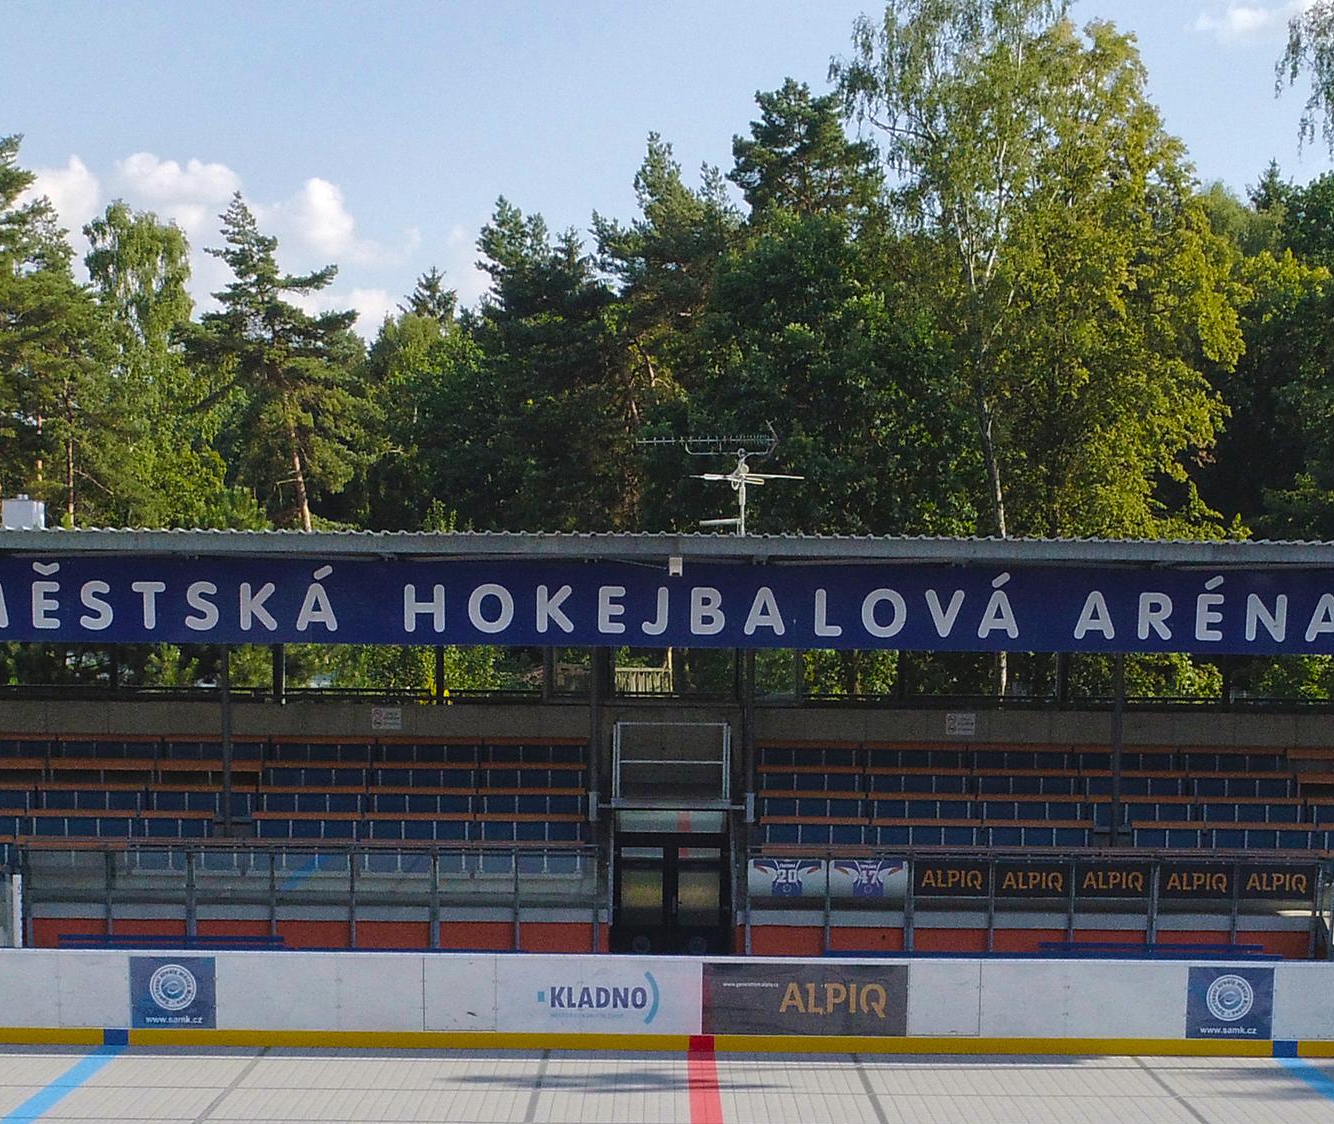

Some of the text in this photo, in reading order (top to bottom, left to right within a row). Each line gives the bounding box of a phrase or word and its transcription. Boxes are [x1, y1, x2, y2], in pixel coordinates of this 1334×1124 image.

[403, 572, 1019, 638] HOKEJBALOVÁ
[777, 869, 797, 883] 20
[921, 870, 983, 890] ALPIQ
[1002, 871, 1064, 892] ALPIQ
[1082, 871, 1144, 892] ALPIQ
[1167, 873, 1227, 893] ALPIQ
[1246, 873, 1307, 894] ALPIQ
[551, 987, 647, 1009] KLADNO
[779, 982, 887, 1018] ALPIQ
[145, 1015, 202, 1024] www.samk.cz
[1200, 1026, 1257, 1034] www.samk.cz
